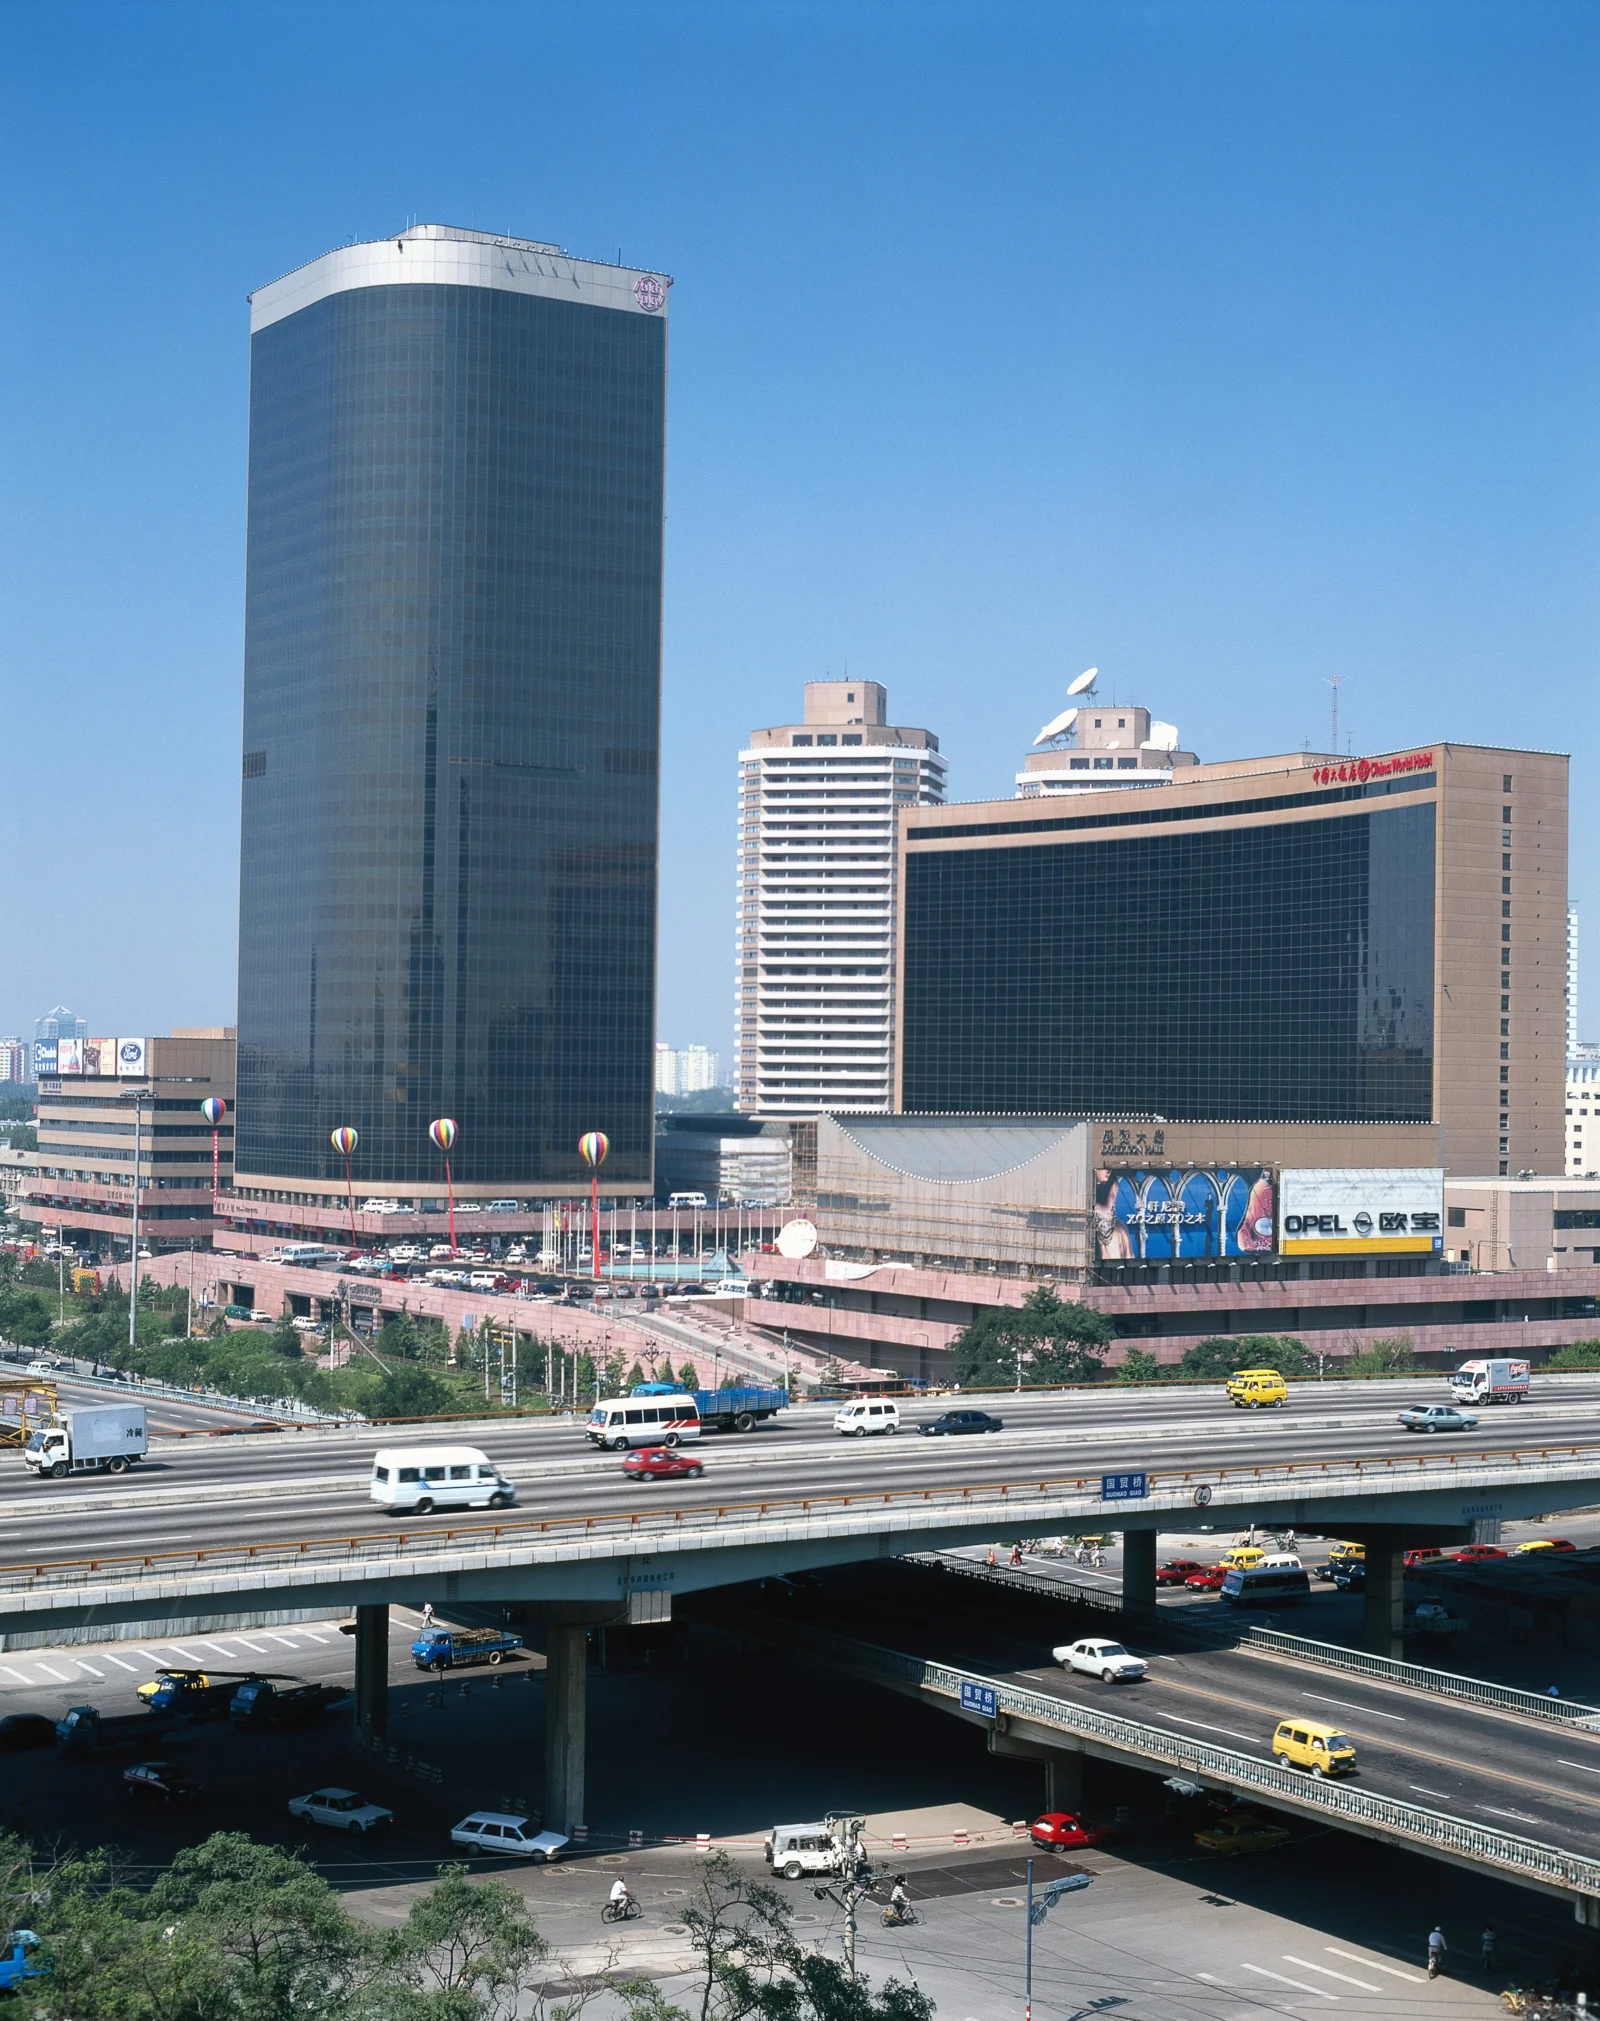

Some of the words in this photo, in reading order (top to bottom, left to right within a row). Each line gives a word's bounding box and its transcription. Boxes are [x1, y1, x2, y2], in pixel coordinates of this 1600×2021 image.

[1371, 762, 1392, 777] China
[1391, 756, 1413, 773] World
[1413, 752, 1433, 771] Hotel
[124, 1045, 138, 1060] Ford
[1284, 1215, 1347, 1232] OPEL
[1379, 1212, 1440, 1230] 欧宝
[1106, 1476, 1142, 1489] 国贸桥
[964, 1685, 992, 1704] 国贸桥
[963, 1700, 981, 1709] GUOMAO
[982, 1705, 992, 1713] QIAO
